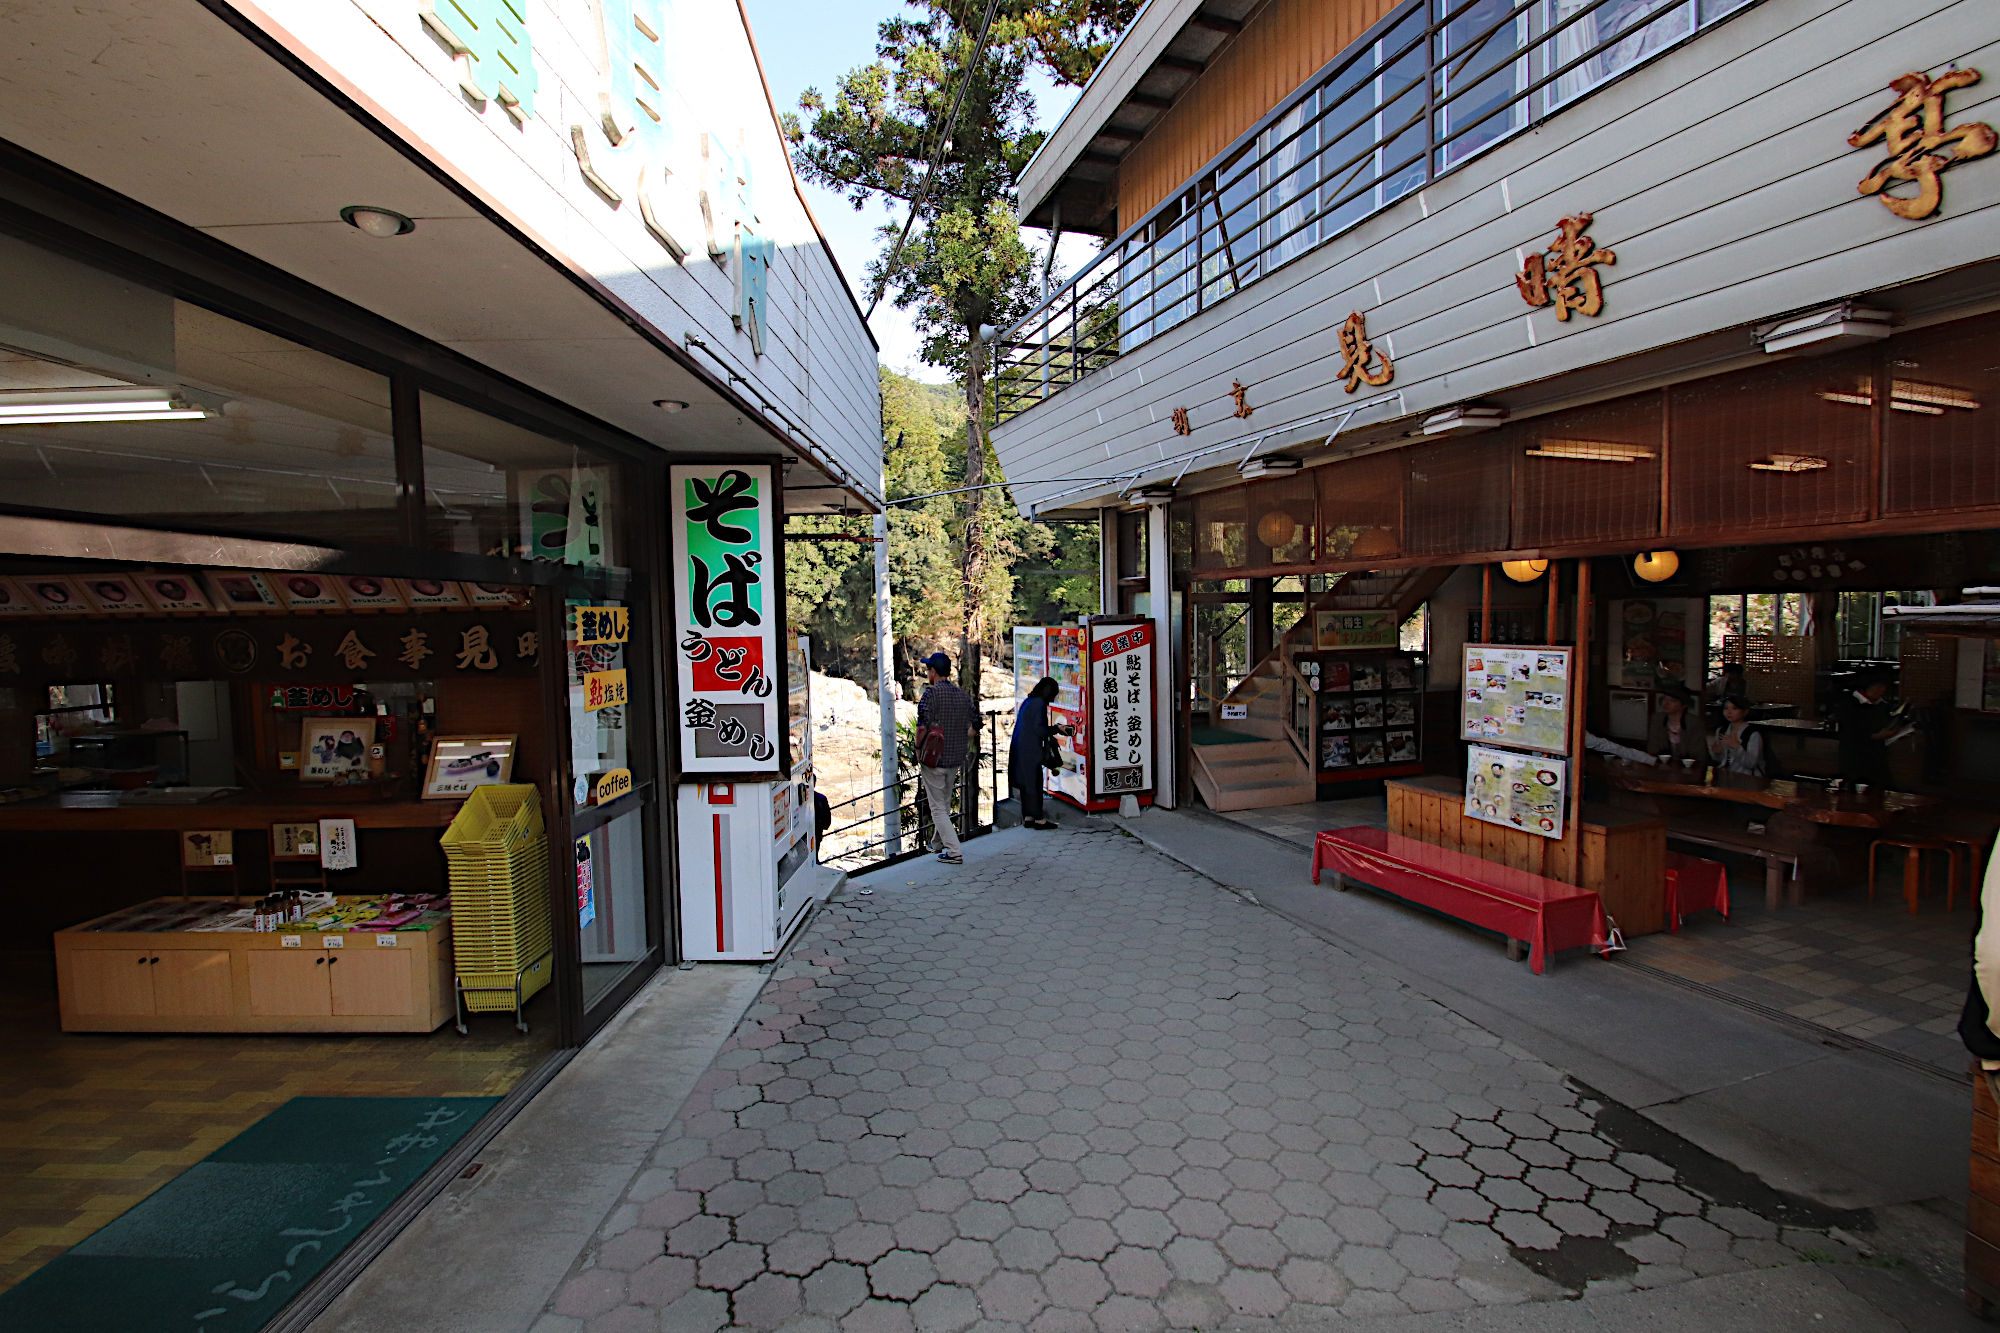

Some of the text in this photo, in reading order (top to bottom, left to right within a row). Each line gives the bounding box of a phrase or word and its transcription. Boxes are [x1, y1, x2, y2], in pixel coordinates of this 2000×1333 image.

[685, 469, 762, 630] そば
[580, 611, 627, 642] 釜めし
[1101, 631, 1144, 655] 営業中
[680, 629, 773, 698] うどん
[286, 687, 353, 708] 釜めし
[1103, 660, 1119, 761] 川魚山菜定食
[684, 697, 775, 762] 釜めし
[598, 775, 630, 799] coffee
[1105, 770, 1143, 790] 見晴
